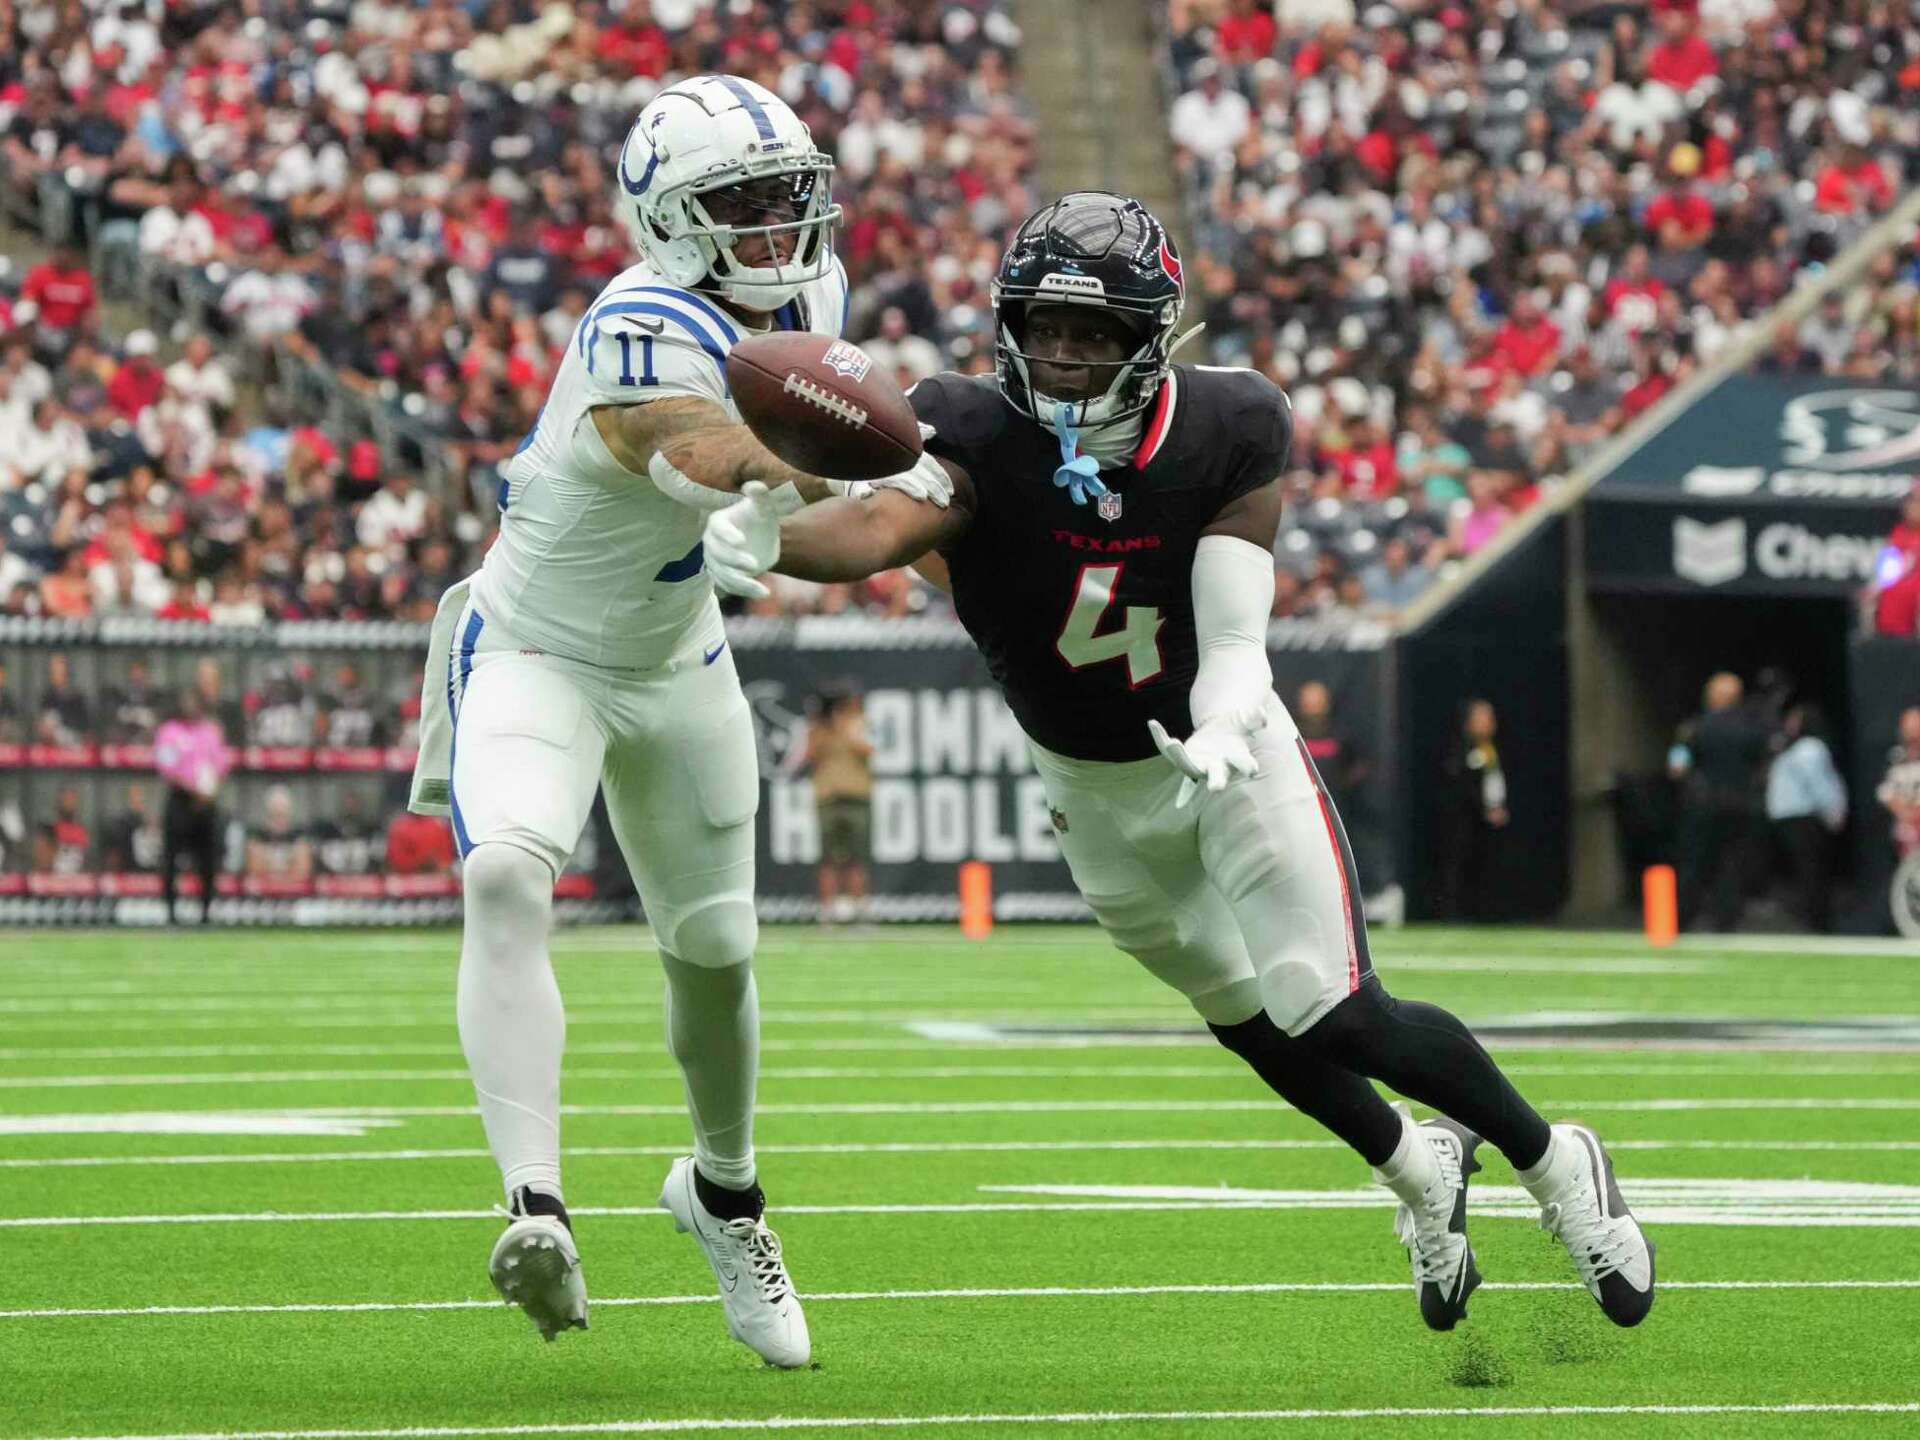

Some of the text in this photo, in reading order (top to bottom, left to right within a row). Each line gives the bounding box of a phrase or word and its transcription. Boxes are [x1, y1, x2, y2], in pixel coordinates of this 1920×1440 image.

[1047, 277, 1099, 289] TEXANS
[614, 330, 660, 386] 11
[1053, 529, 1161, 550] TEXANS
[1056, 561, 1169, 690] 4
[769, 776, 1061, 864] HDDLE
[1428, 1137, 1465, 1190] NIKE
